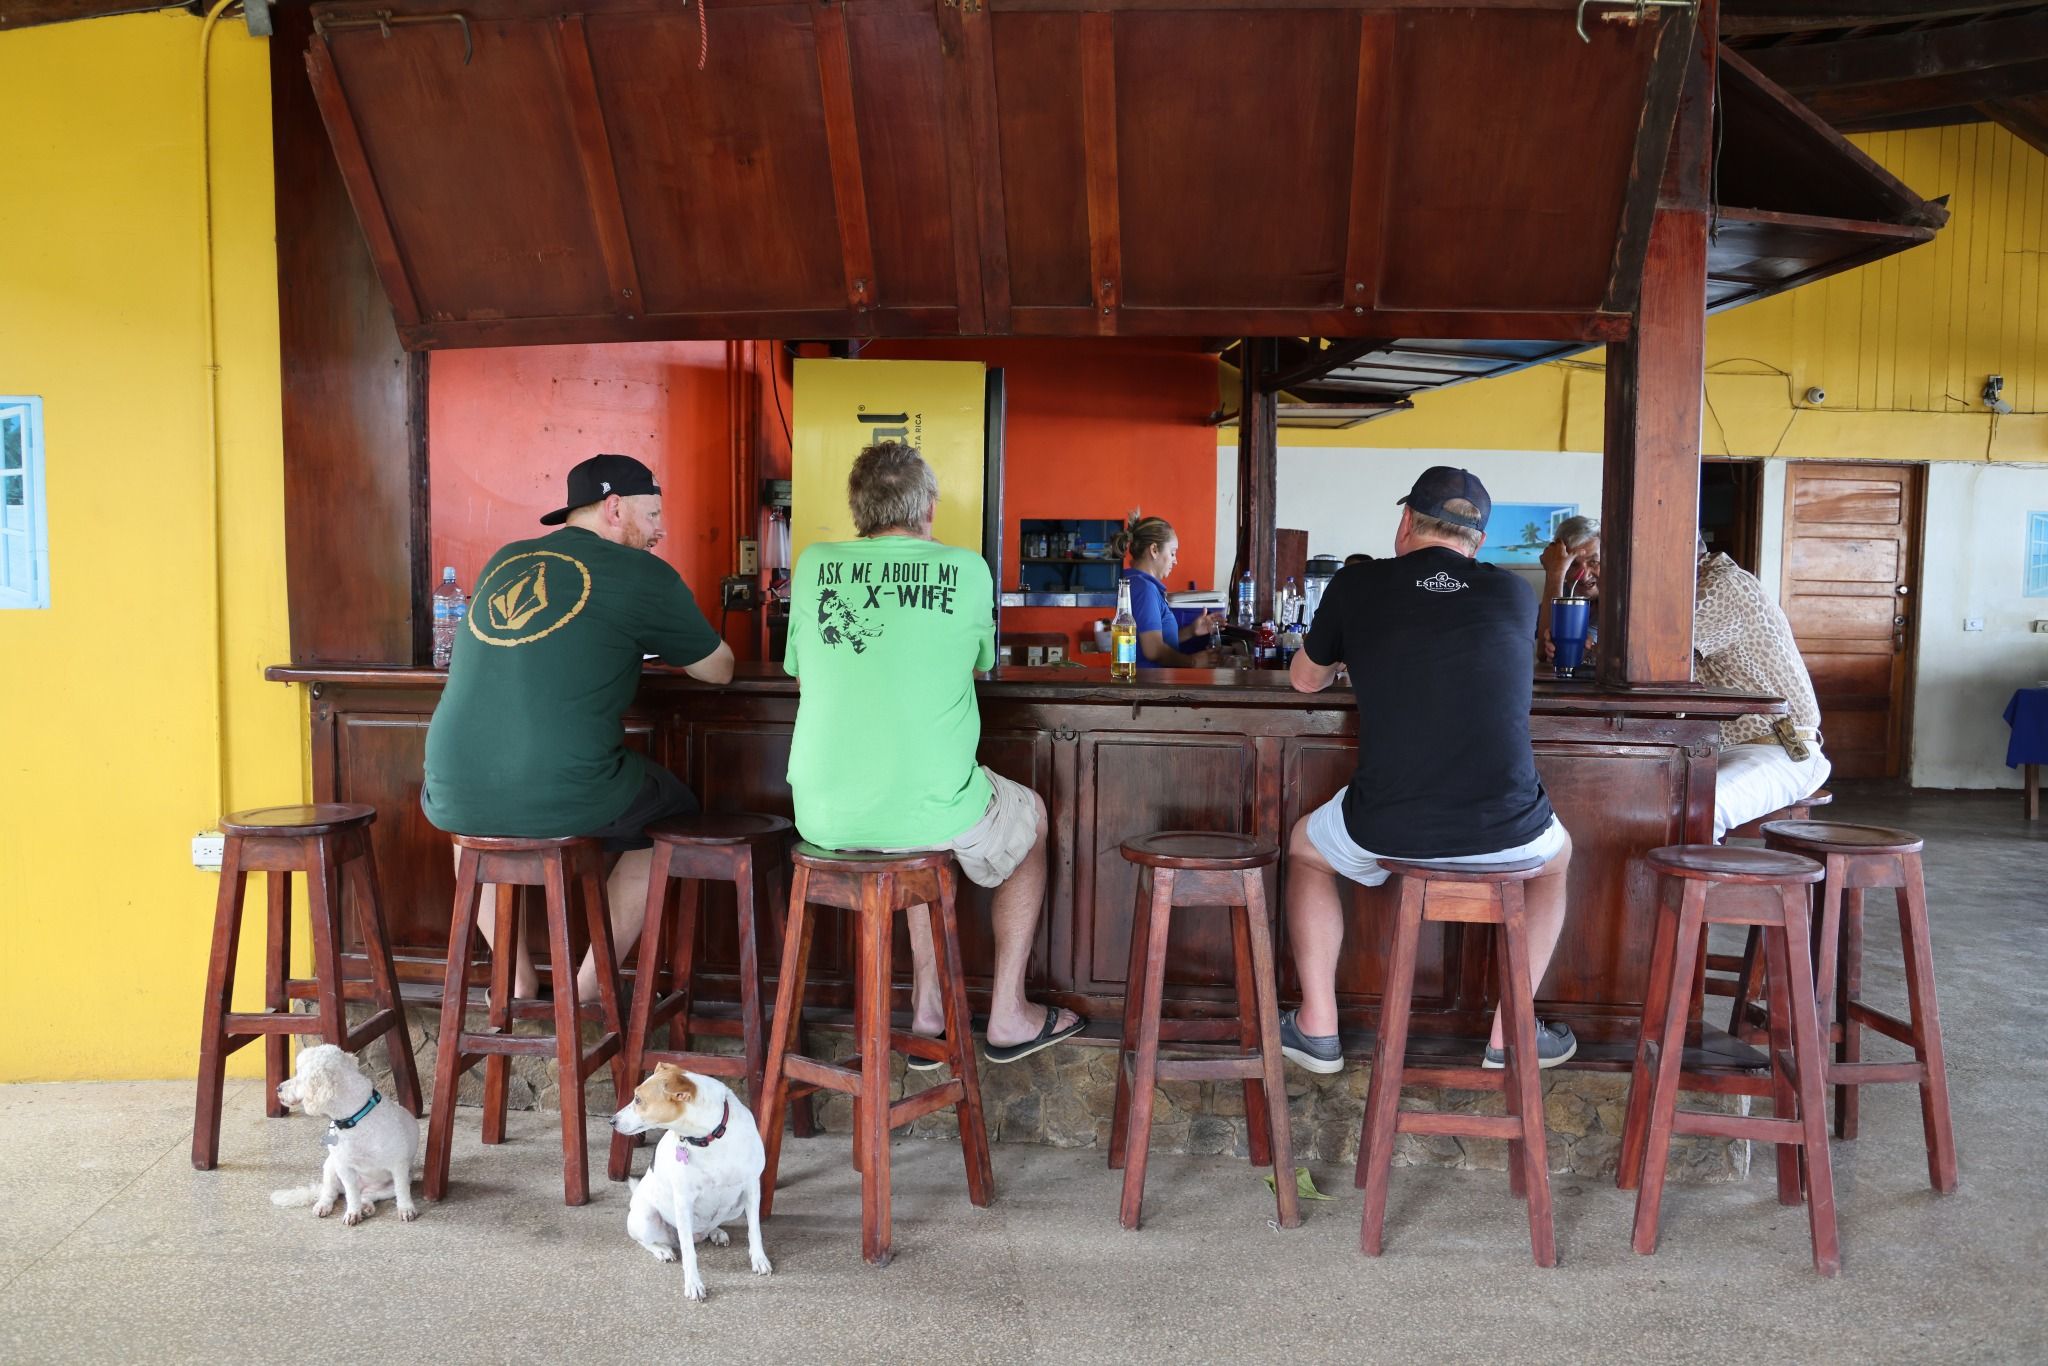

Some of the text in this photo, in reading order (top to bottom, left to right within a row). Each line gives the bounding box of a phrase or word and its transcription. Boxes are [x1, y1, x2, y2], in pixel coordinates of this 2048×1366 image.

[914, 413, 922, 432] RICA
[817, 562, 958, 587] ASK ME ABOUT MY
[1416, 580, 1469, 589] ESPINOSA
[863, 584, 957, 615] X-WIFE
